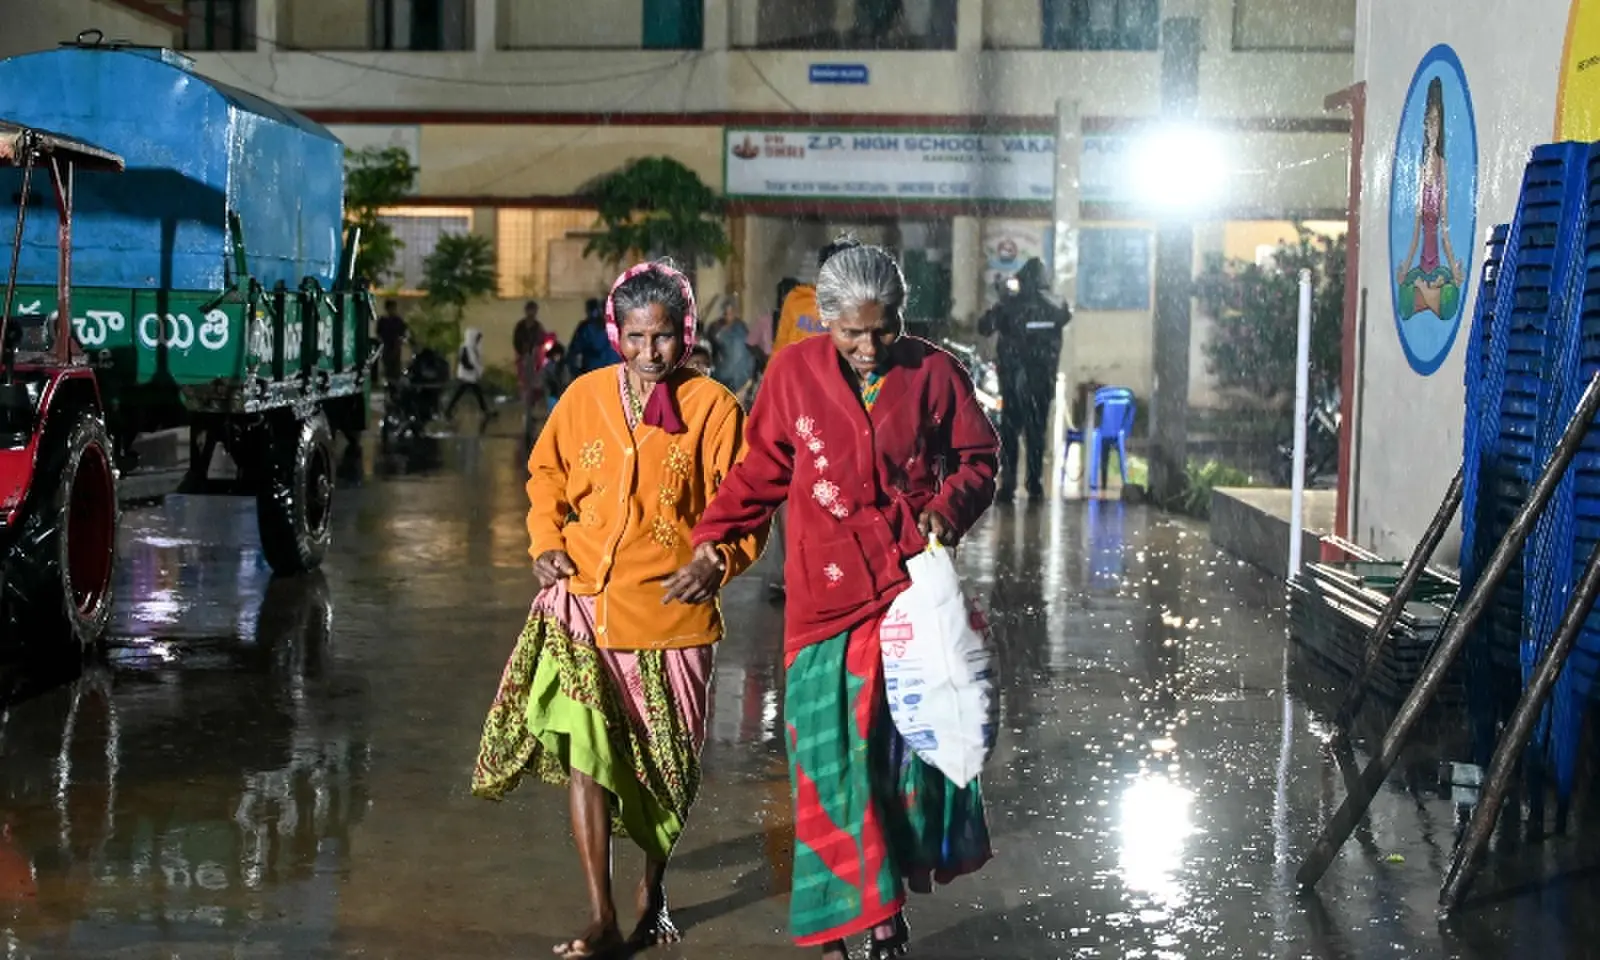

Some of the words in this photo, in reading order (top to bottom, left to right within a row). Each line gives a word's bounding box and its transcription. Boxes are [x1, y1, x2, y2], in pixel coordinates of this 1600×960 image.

[807, 136, 846, 151] Z.P.
[852, 137, 899, 151] HIGH
[904, 137, 987, 152] SCHOOL
